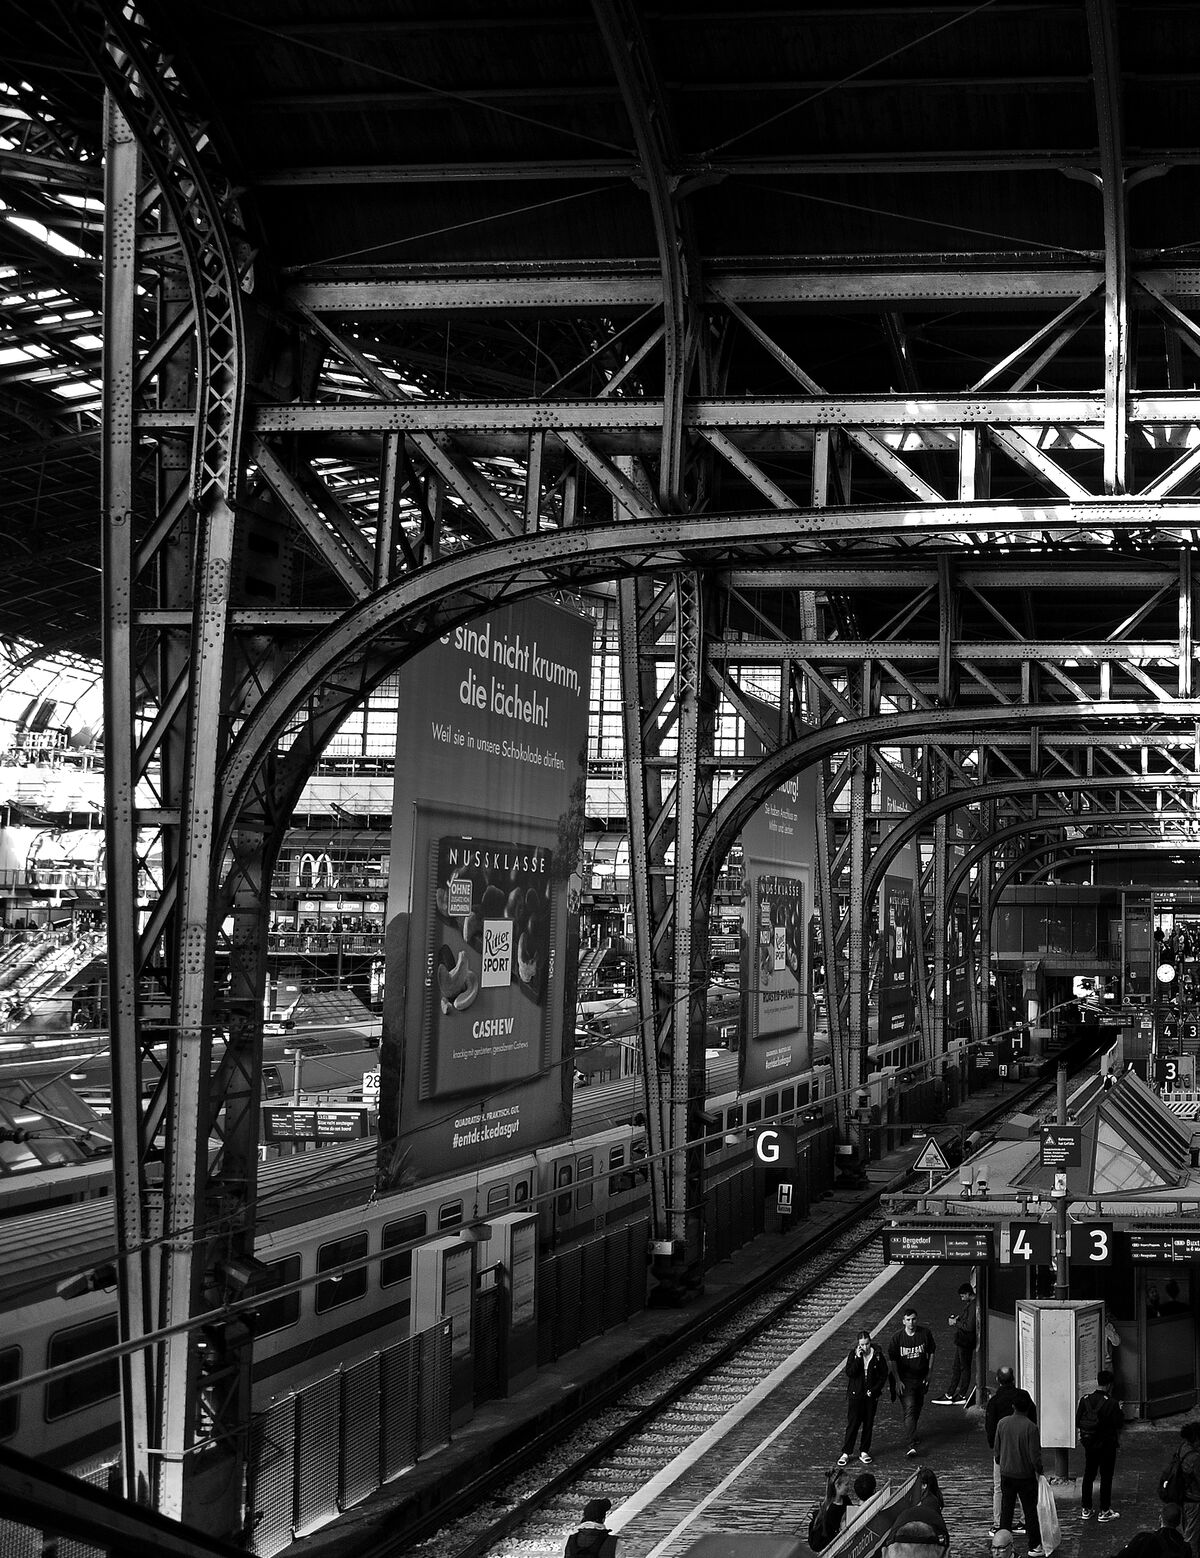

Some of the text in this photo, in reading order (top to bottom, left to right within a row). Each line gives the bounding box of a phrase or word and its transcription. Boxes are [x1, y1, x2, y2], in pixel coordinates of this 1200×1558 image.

[454, 622, 581, 697] sind nicht krumm,
[459, 668, 549, 728] die lächeln!
[432, 722, 565, 770] Weil sie in unsere Schokolade dürfen.
[449, 848, 545, 873] NUSSKLASSE
[451, 883, 470, 895] OHNE
[485, 929, 510, 956] Ritter
[483, 957, 509, 972] SPORT
[472, 1017, 514, 1039] CASHEW
[1163, 1025, 1172, 1037] 4
[1189, 1025, 1197, 1037] 3
[366, 1074, 380, 1088] 28
[1165, 1062, 1176, 1080] 3
[756, 1130, 780, 1163] G
[779, 1185, 791, 1203] H
[902, 1236, 931, 1245] Bergedorf
[1012, 1229, 1033, 1260] 4
[1089, 1229, 1109, 1261] 3
